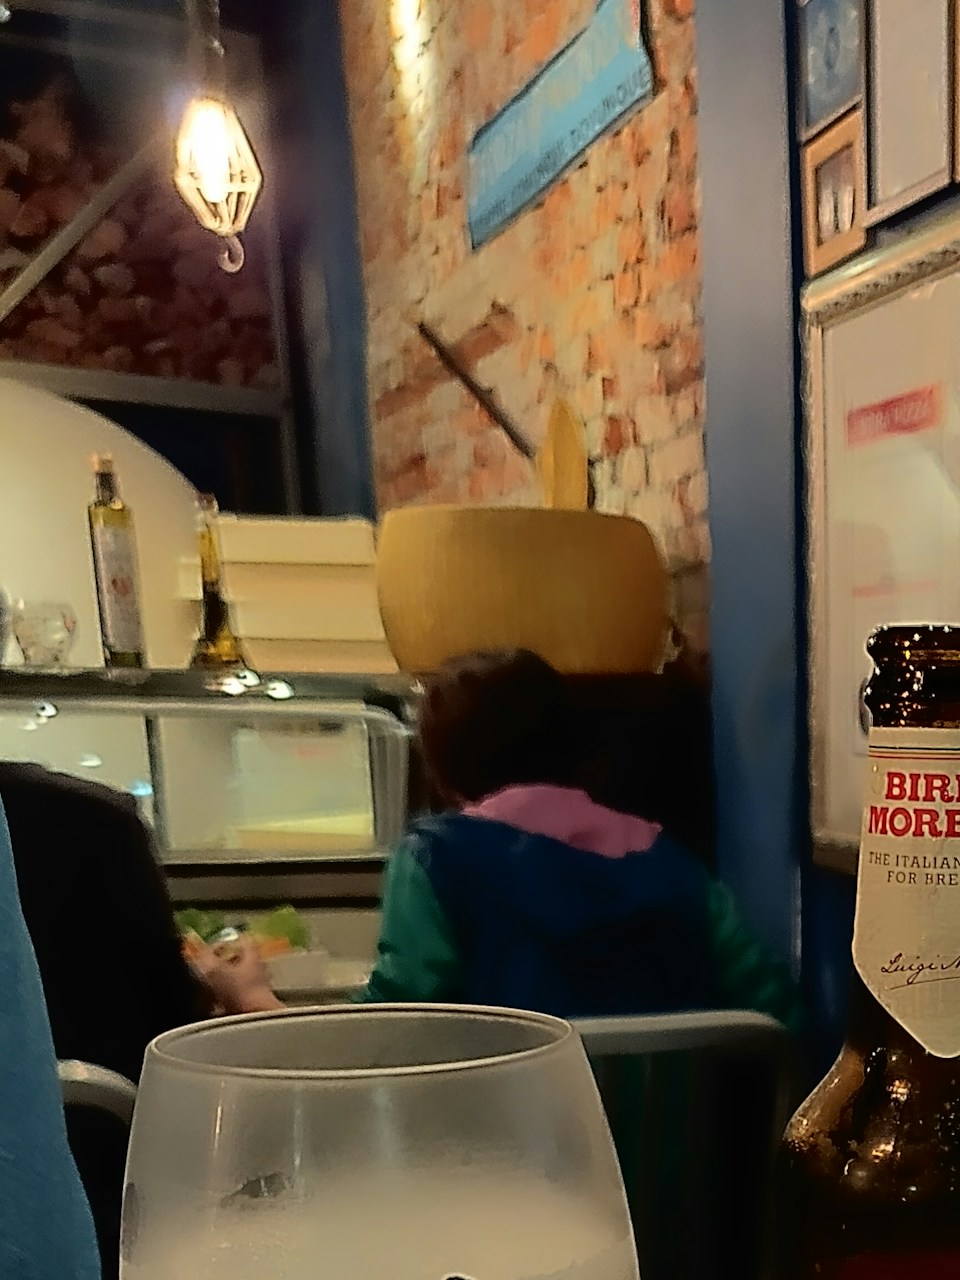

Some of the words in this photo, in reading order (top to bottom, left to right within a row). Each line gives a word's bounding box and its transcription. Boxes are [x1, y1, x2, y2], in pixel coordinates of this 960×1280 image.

[868, 851, 892, 868] THE
[887, 871, 918, 885] FOR
[880, 952, 940, 984] Luigi
